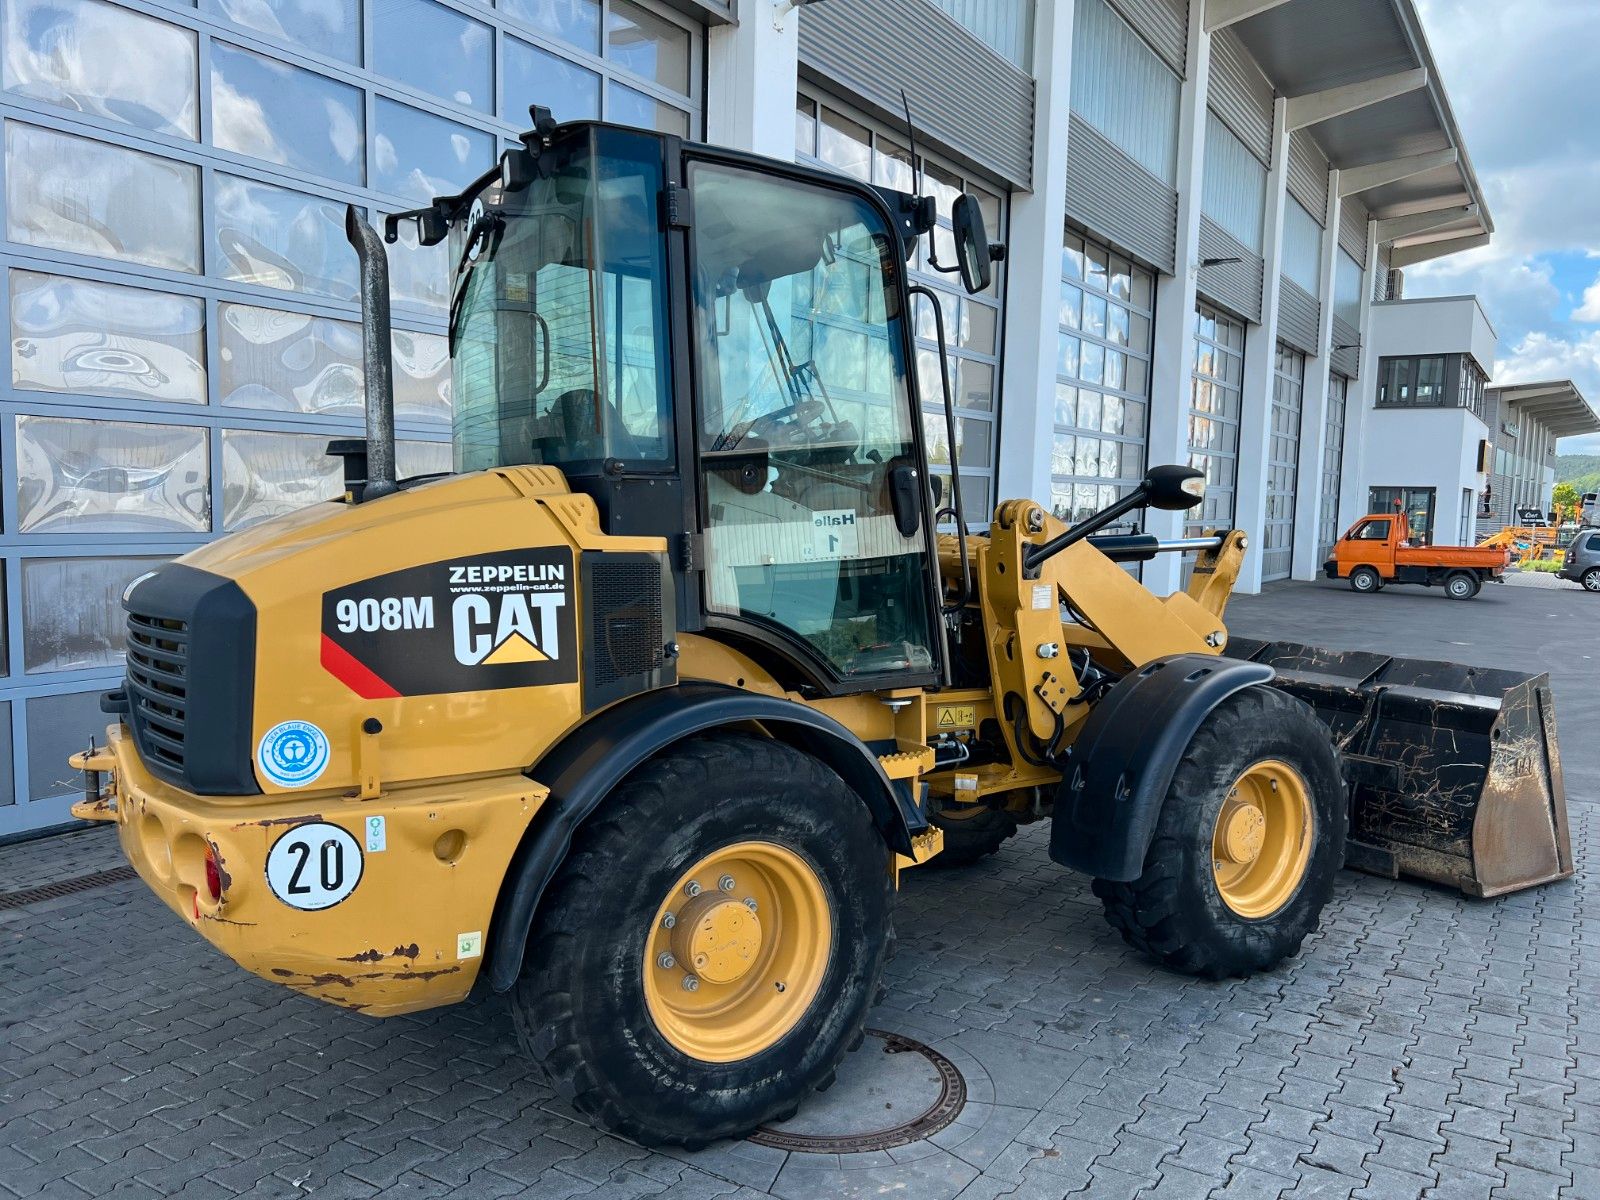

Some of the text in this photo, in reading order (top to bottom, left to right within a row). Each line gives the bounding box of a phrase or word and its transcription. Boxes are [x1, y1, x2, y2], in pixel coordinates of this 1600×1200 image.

[449, 564, 565, 584] ZEPPELIN
[449, 583, 565, 593] www.zeppelin-cat.de
[336, 596, 434, 634] 908M
[452, 592, 566, 666] CAT
[287, 839, 344, 895] 20
